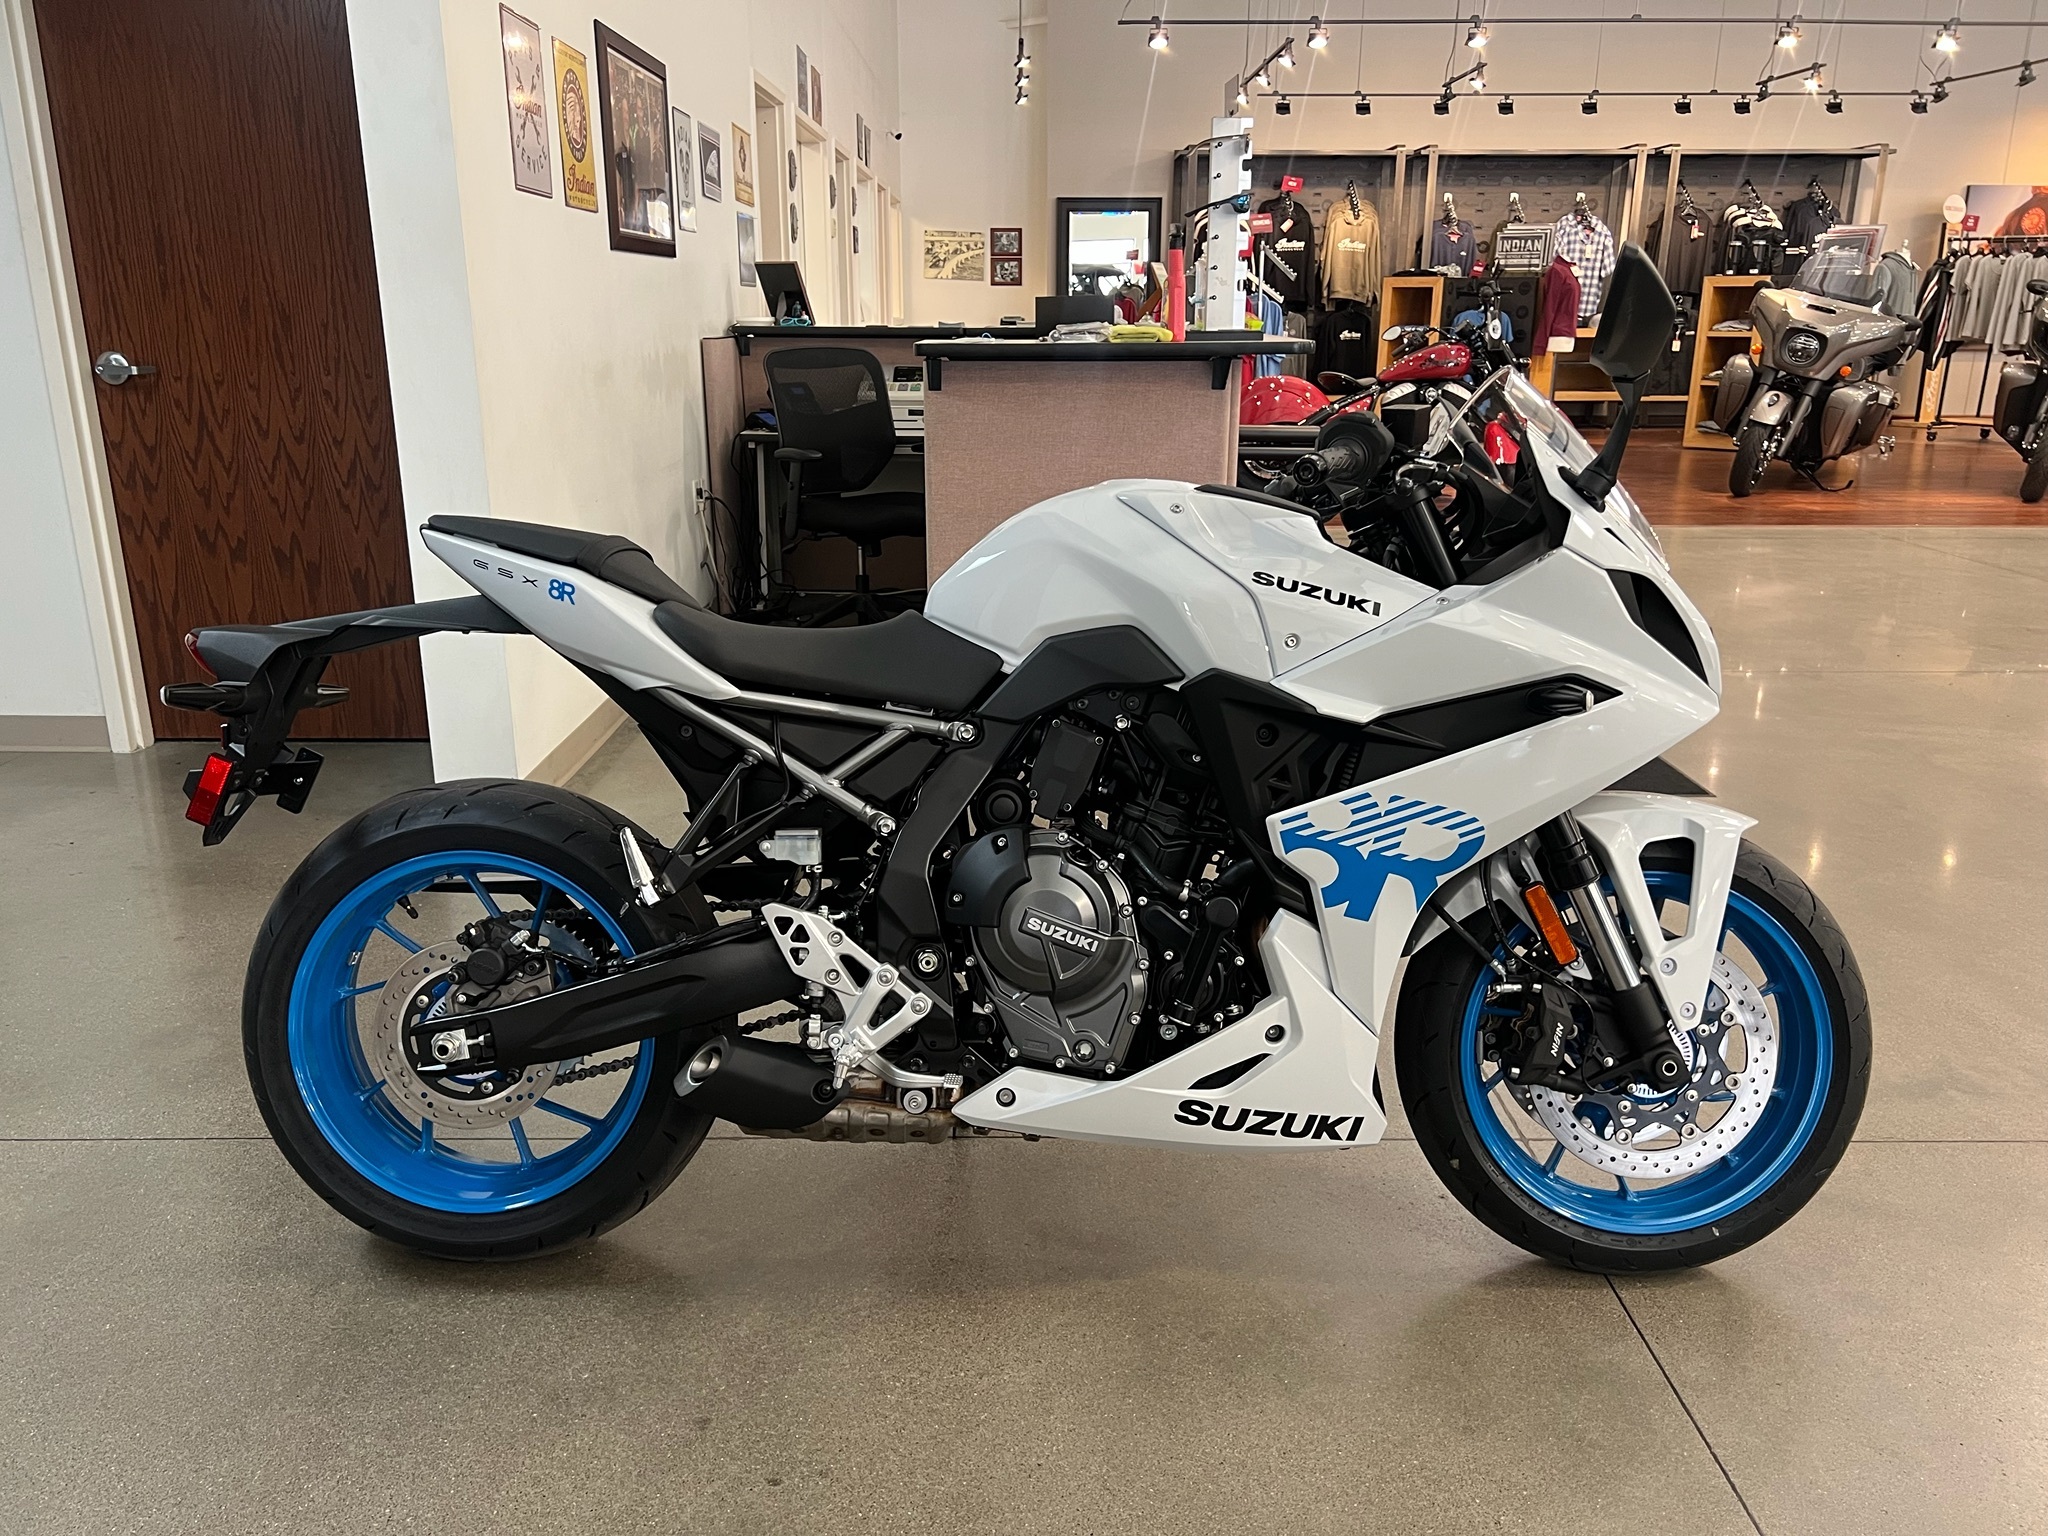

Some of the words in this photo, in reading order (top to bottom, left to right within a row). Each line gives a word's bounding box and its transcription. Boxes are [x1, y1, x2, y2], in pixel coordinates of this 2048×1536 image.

[566, 163, 595, 196] Indian
[1499, 239, 1541, 252] INDIAN
[548, 578, 576, 605] 8R
[1251, 571, 1382, 617] SUZUKI
[1027, 917, 1099, 952] SUZUKI
[1174, 1099, 1365, 1142] SUZUKI
